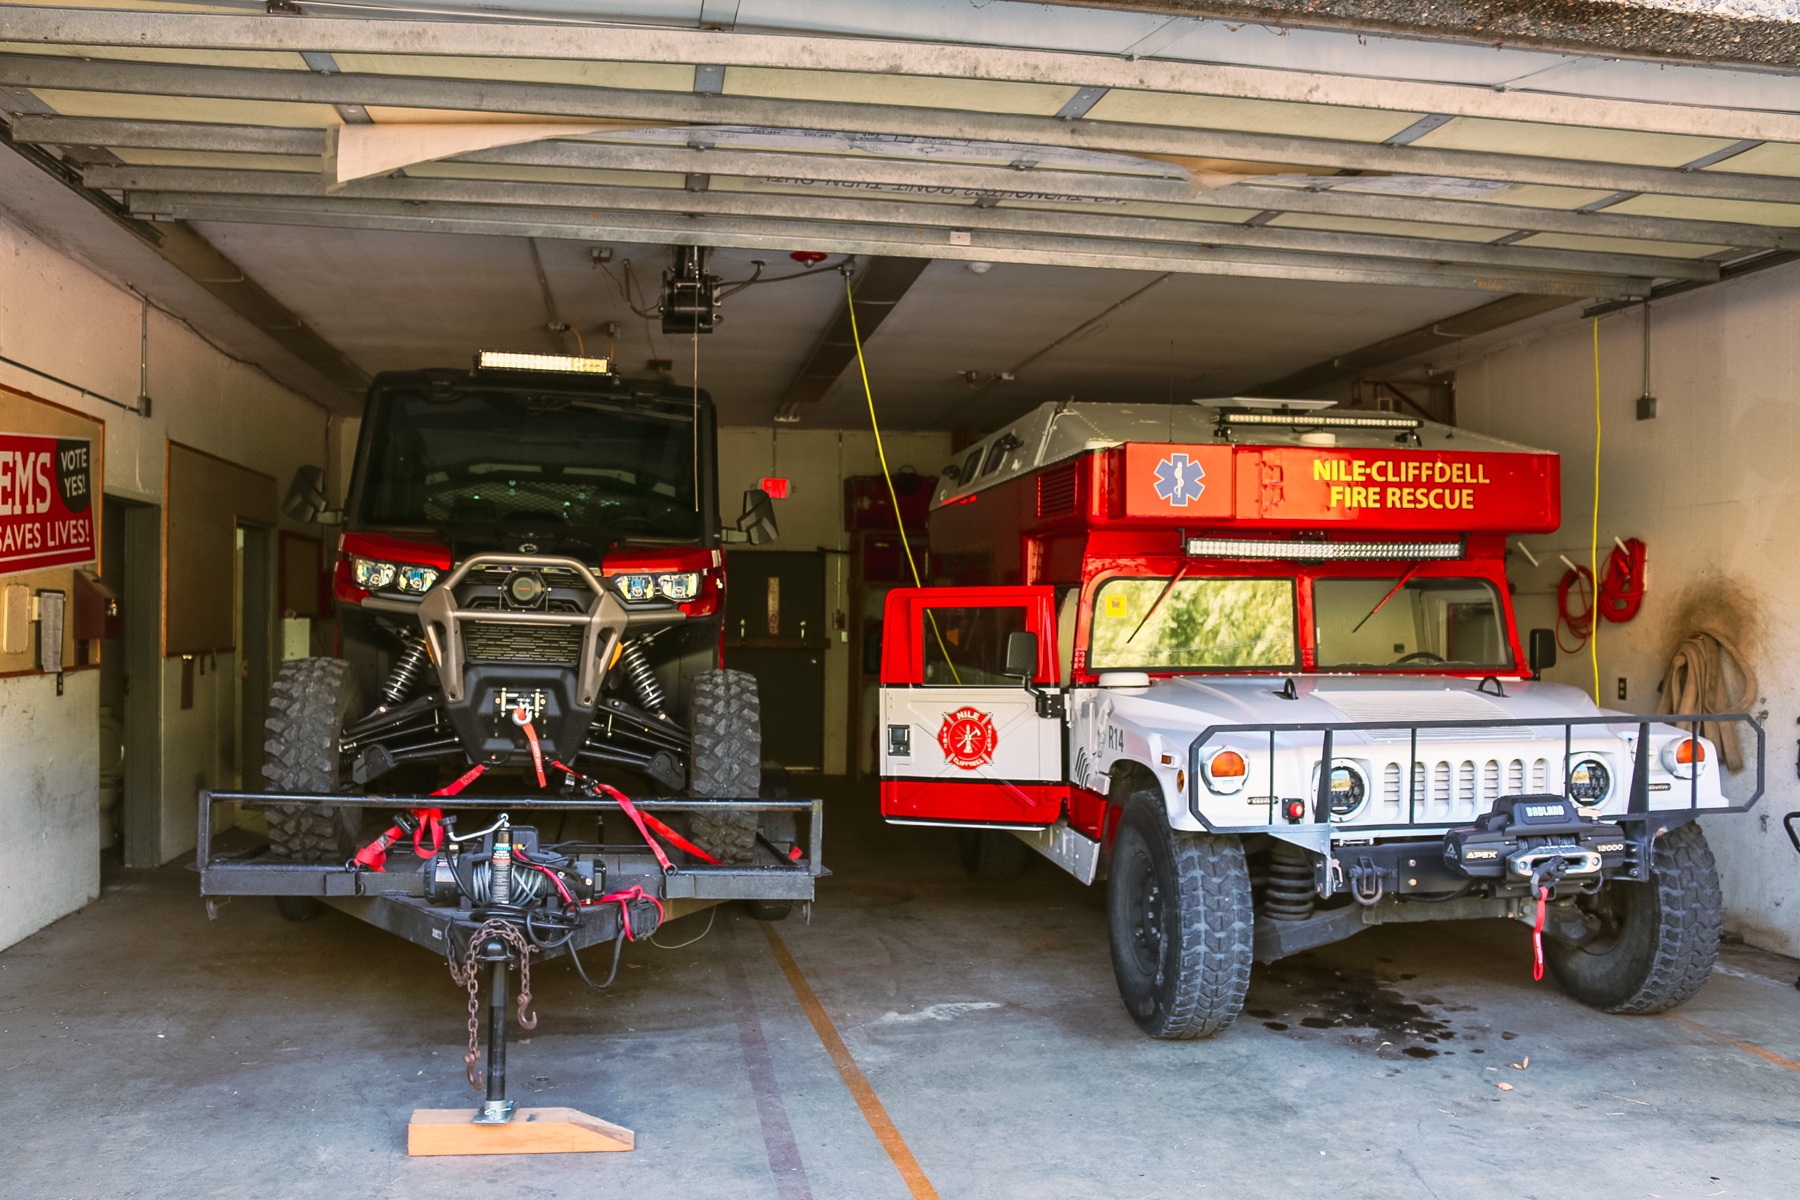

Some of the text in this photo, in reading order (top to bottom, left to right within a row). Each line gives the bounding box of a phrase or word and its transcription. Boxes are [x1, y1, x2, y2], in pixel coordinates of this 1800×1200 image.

[61, 448, 87, 472] VOTE
[0, 450, 51, 516] EMS
[64, 474, 86, 498] YES!
[1330, 486, 1474, 510] FIRE RESCUE
[0, 519, 90, 552] AVES LIVES!
[955, 710, 980, 721] NILE
[1108, 725, 1124, 753] R14
[1465, 851, 1498, 860] APEX
[1596, 844, 1624, 853] 12000
